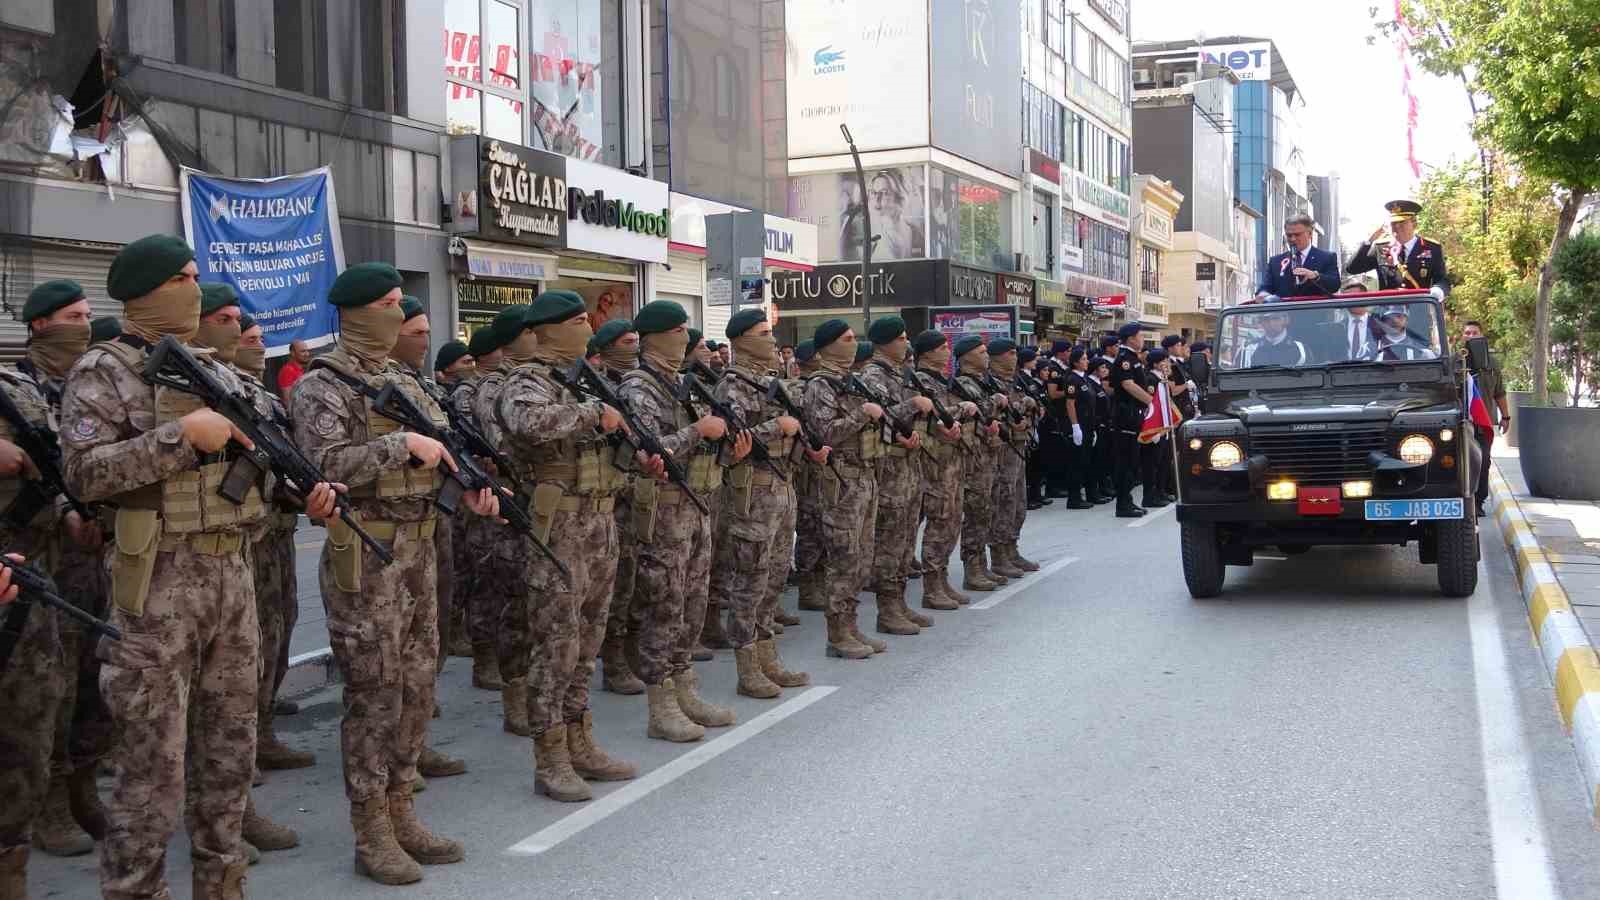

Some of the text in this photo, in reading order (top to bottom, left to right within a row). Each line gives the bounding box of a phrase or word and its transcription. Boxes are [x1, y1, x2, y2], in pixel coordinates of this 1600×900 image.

[814, 64, 845, 75] LACOSTE
[490, 160, 567, 211] ÇAĞLAR
[499, 204, 560, 237] Kuyumculuk
[568, 187, 668, 237] PoloMood
[249, 239, 274, 256] PAŞA
[255, 257, 295, 273] BULVARI
[1375, 501, 1461, 516] 65 JAB 025
